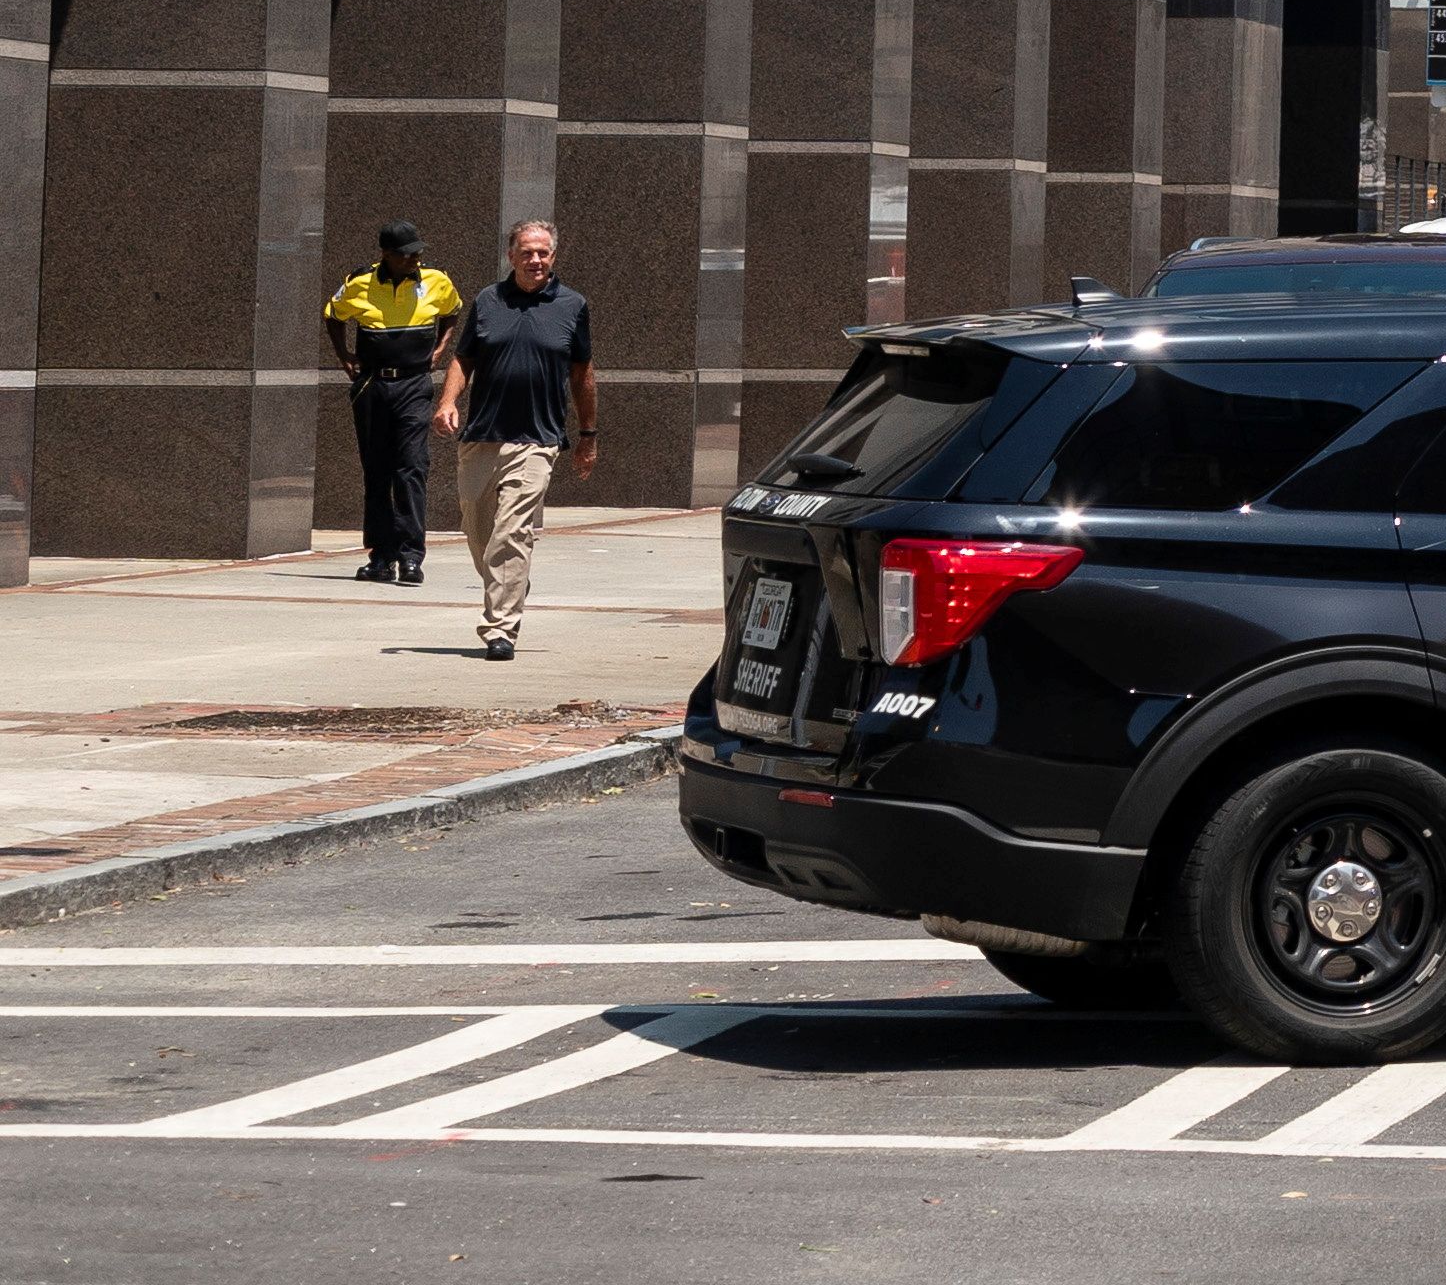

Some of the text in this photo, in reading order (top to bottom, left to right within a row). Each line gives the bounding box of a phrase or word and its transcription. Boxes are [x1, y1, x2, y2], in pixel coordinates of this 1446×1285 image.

[773, 493, 832, 517] COUNTY
[734, 657, 782, 699] SHERIFF
[872, 692, 936, 719] A007
